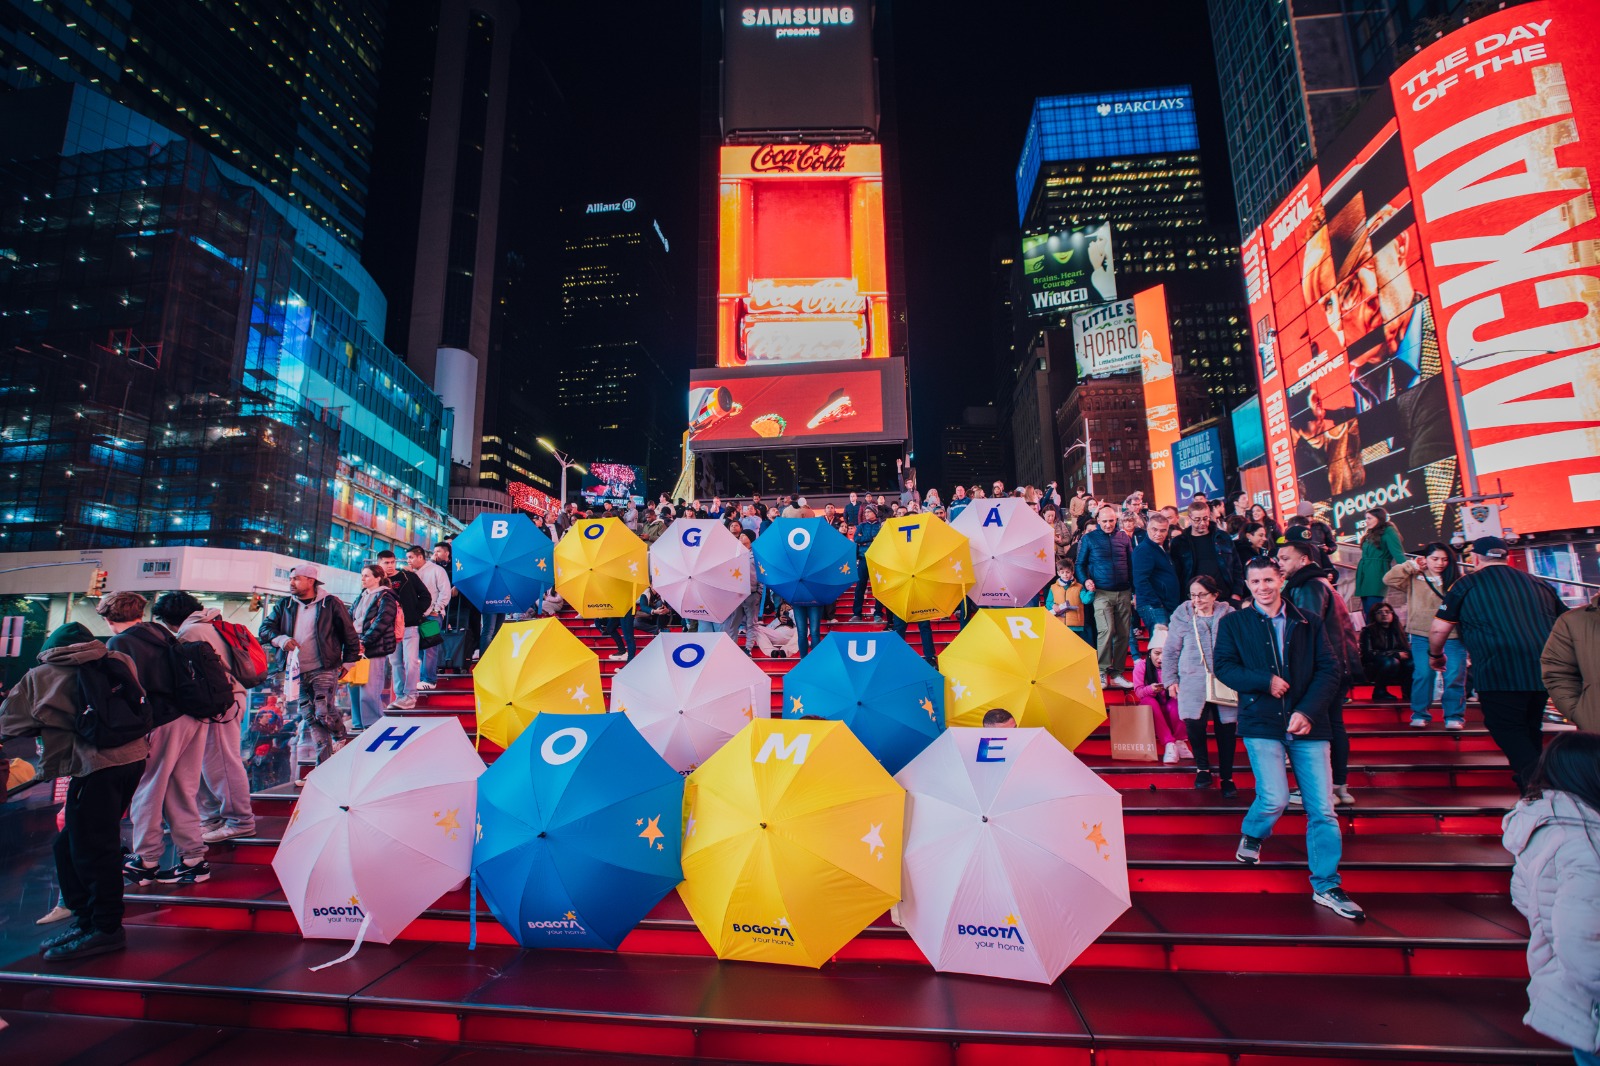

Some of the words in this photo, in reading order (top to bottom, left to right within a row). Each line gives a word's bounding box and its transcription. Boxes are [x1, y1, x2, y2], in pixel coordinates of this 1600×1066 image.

[742, 7, 854, 26] SAMSUNG
[776, 27, 820, 38] presents
[1400, 46, 1470, 96] THE
[1474, 18, 1552, 57] DAY
[1412, 73, 1459, 112] OF
[1464, 42, 1547, 80] THE
[1114, 97, 1185, 114] BARCLAYS
[585, 202, 621, 214] Allianz
[1033, 275, 1060, 285] Brains.
[1061, 269, 1085, 279] Heart.
[1042, 278, 1077, 289] Courage.
[1413, 63, 1600, 503] JACKAL
[1082, 303, 1124, 333] LITTLE
[1083, 324, 1138, 367] HORRO
[1297, 349, 1329, 378] EDDIE
[1287, 354, 1344, 398] REDMAYNE
[1266, 389, 1287, 437] FREE
[1333, 473, 1413, 529] peacock
[982, 504, 1004, 527] Á
[490, 520, 509, 539] B
[583, 523, 605, 540] O
[682, 527, 702, 547] G
[787, 527, 811, 551] O
[898, 523, 920, 543] T
[154, 561, 171, 572] TOWN
[1005, 616, 1040, 639] R
[510, 628, 535, 658] Y
[847, 639, 877, 662] U
[672, 643, 705, 668] O
[365, 725, 421, 752] H
[540, 727, 588, 765] O
[754, 732, 812, 765] M
[975, 737, 1008, 763] E
[1113, 743, 1145, 752] FOREVER
[1147, 743, 1155, 752] 21
[752, 936, 770, 944] your
[771, 937, 795, 947] home
[975, 941, 995, 950] your
[997, 941, 1025, 953] home
